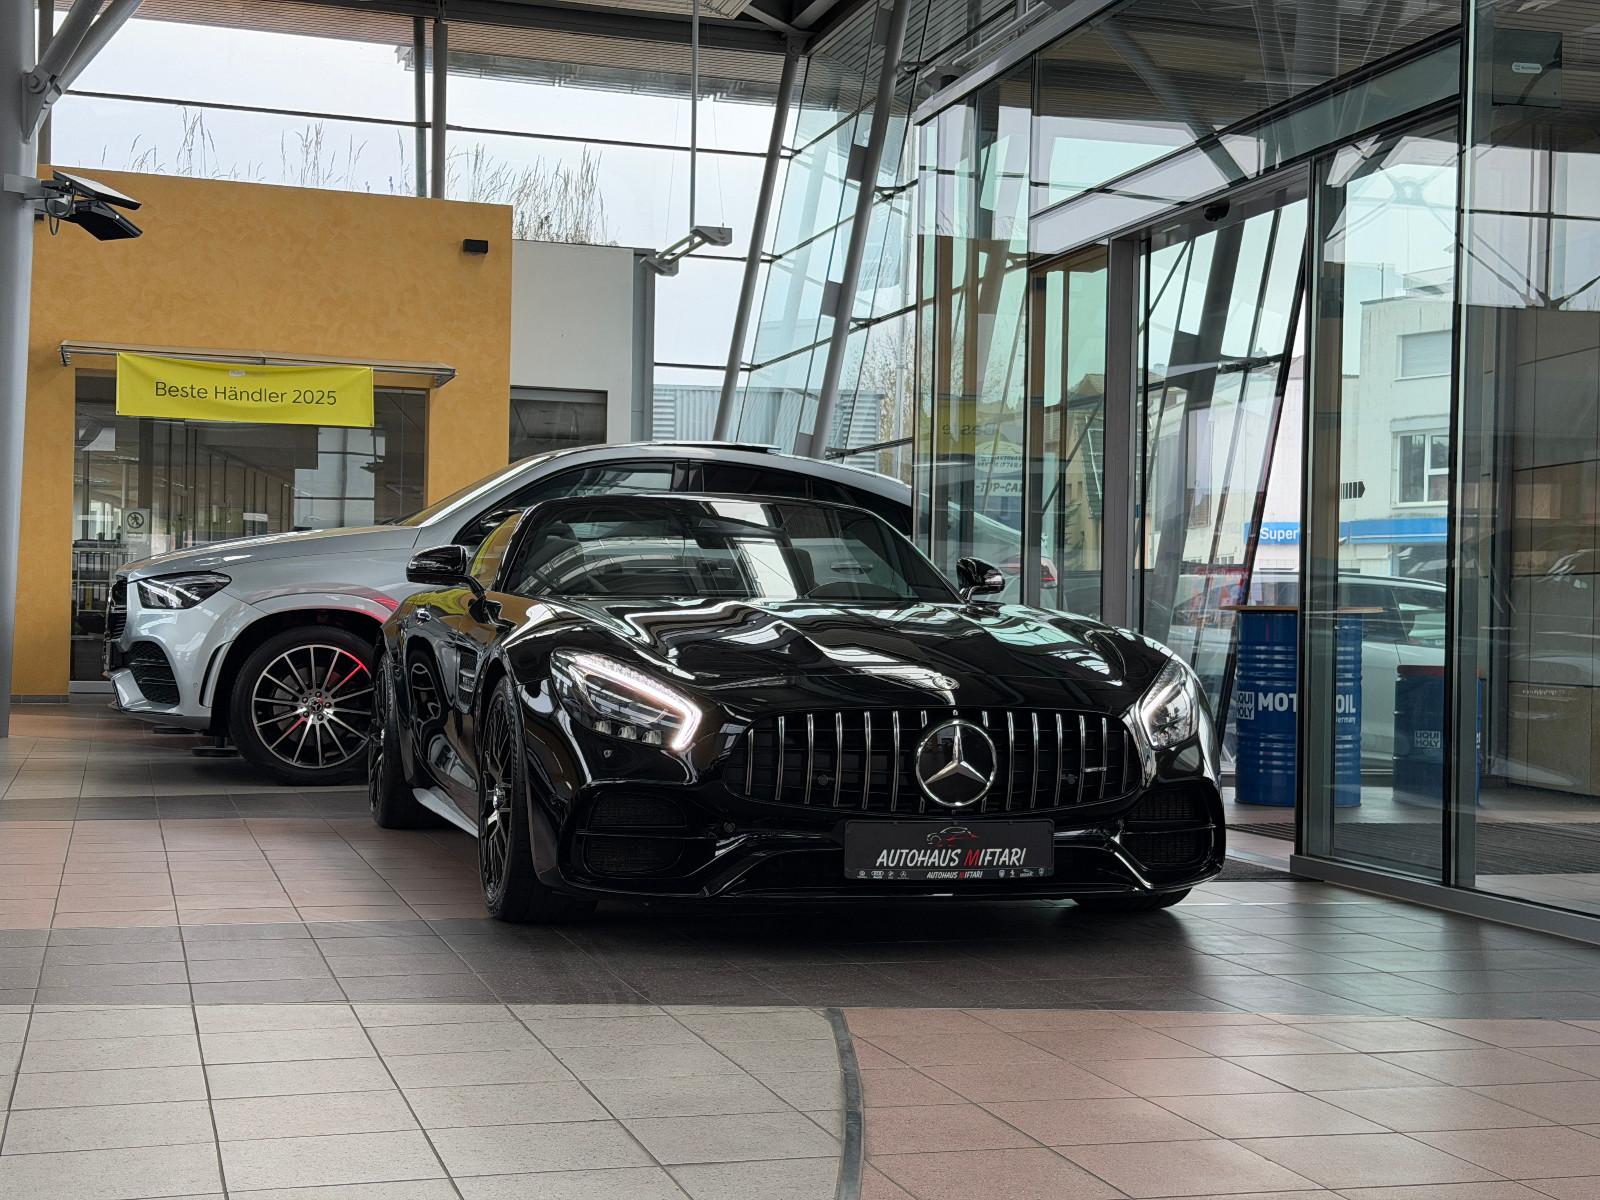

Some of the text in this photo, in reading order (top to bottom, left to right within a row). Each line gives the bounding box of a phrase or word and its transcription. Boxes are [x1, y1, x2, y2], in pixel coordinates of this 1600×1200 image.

[155, 381, 337, 405] Beste Händler 2025
[1260, 527, 1299, 542] Super
[1237, 706, 1253, 719] OLY
[875, 848, 1026, 867] AUTOHAUS MIFTARI
[926, 871, 958, 879] AUTOHAUS
